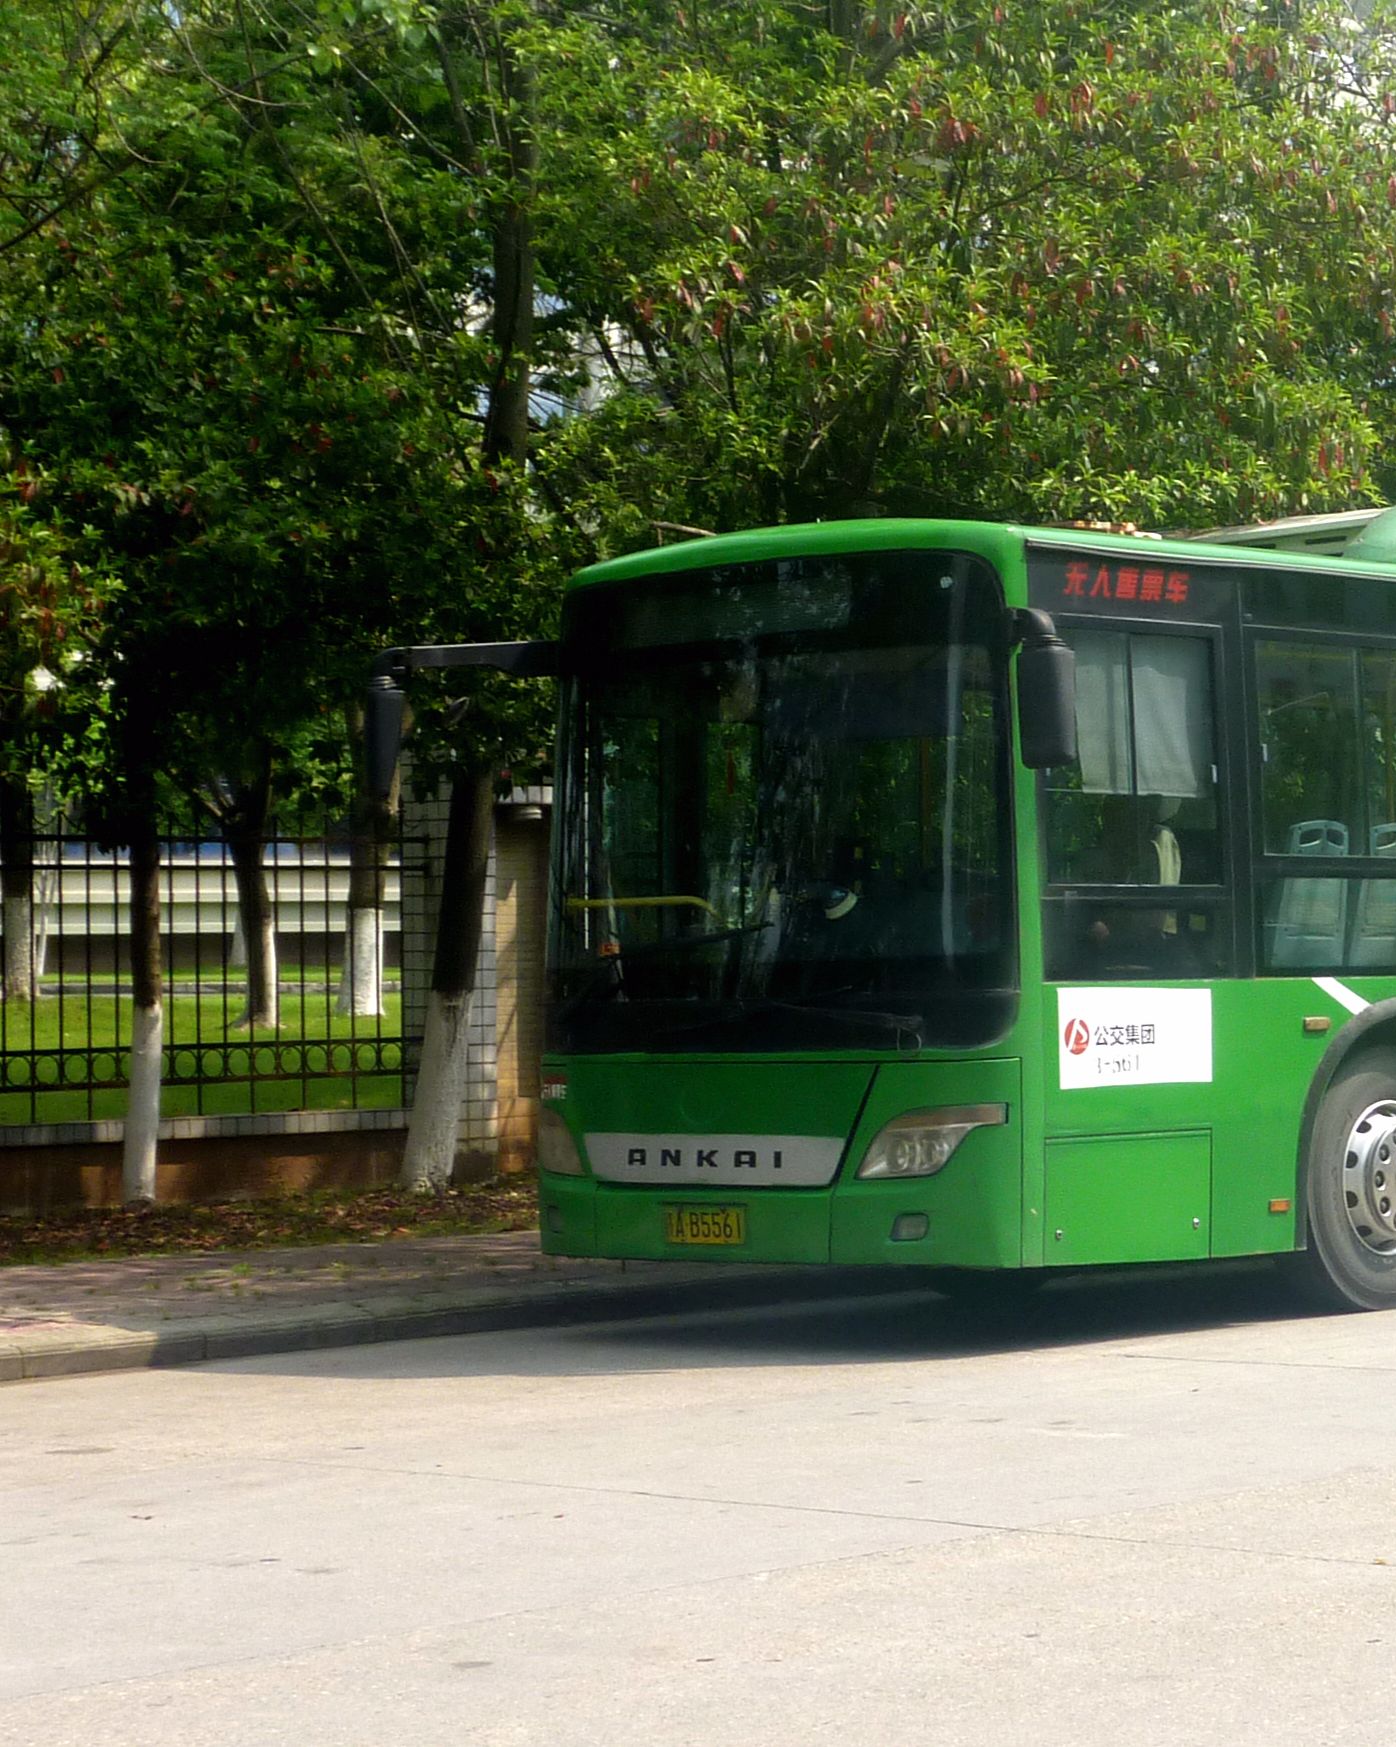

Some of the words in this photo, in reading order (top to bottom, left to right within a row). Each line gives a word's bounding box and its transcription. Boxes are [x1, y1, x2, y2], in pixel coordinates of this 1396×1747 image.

[1094, 1023, 1156, 1047] 公交集团
[628, 1148, 783, 1169] ANKAI
